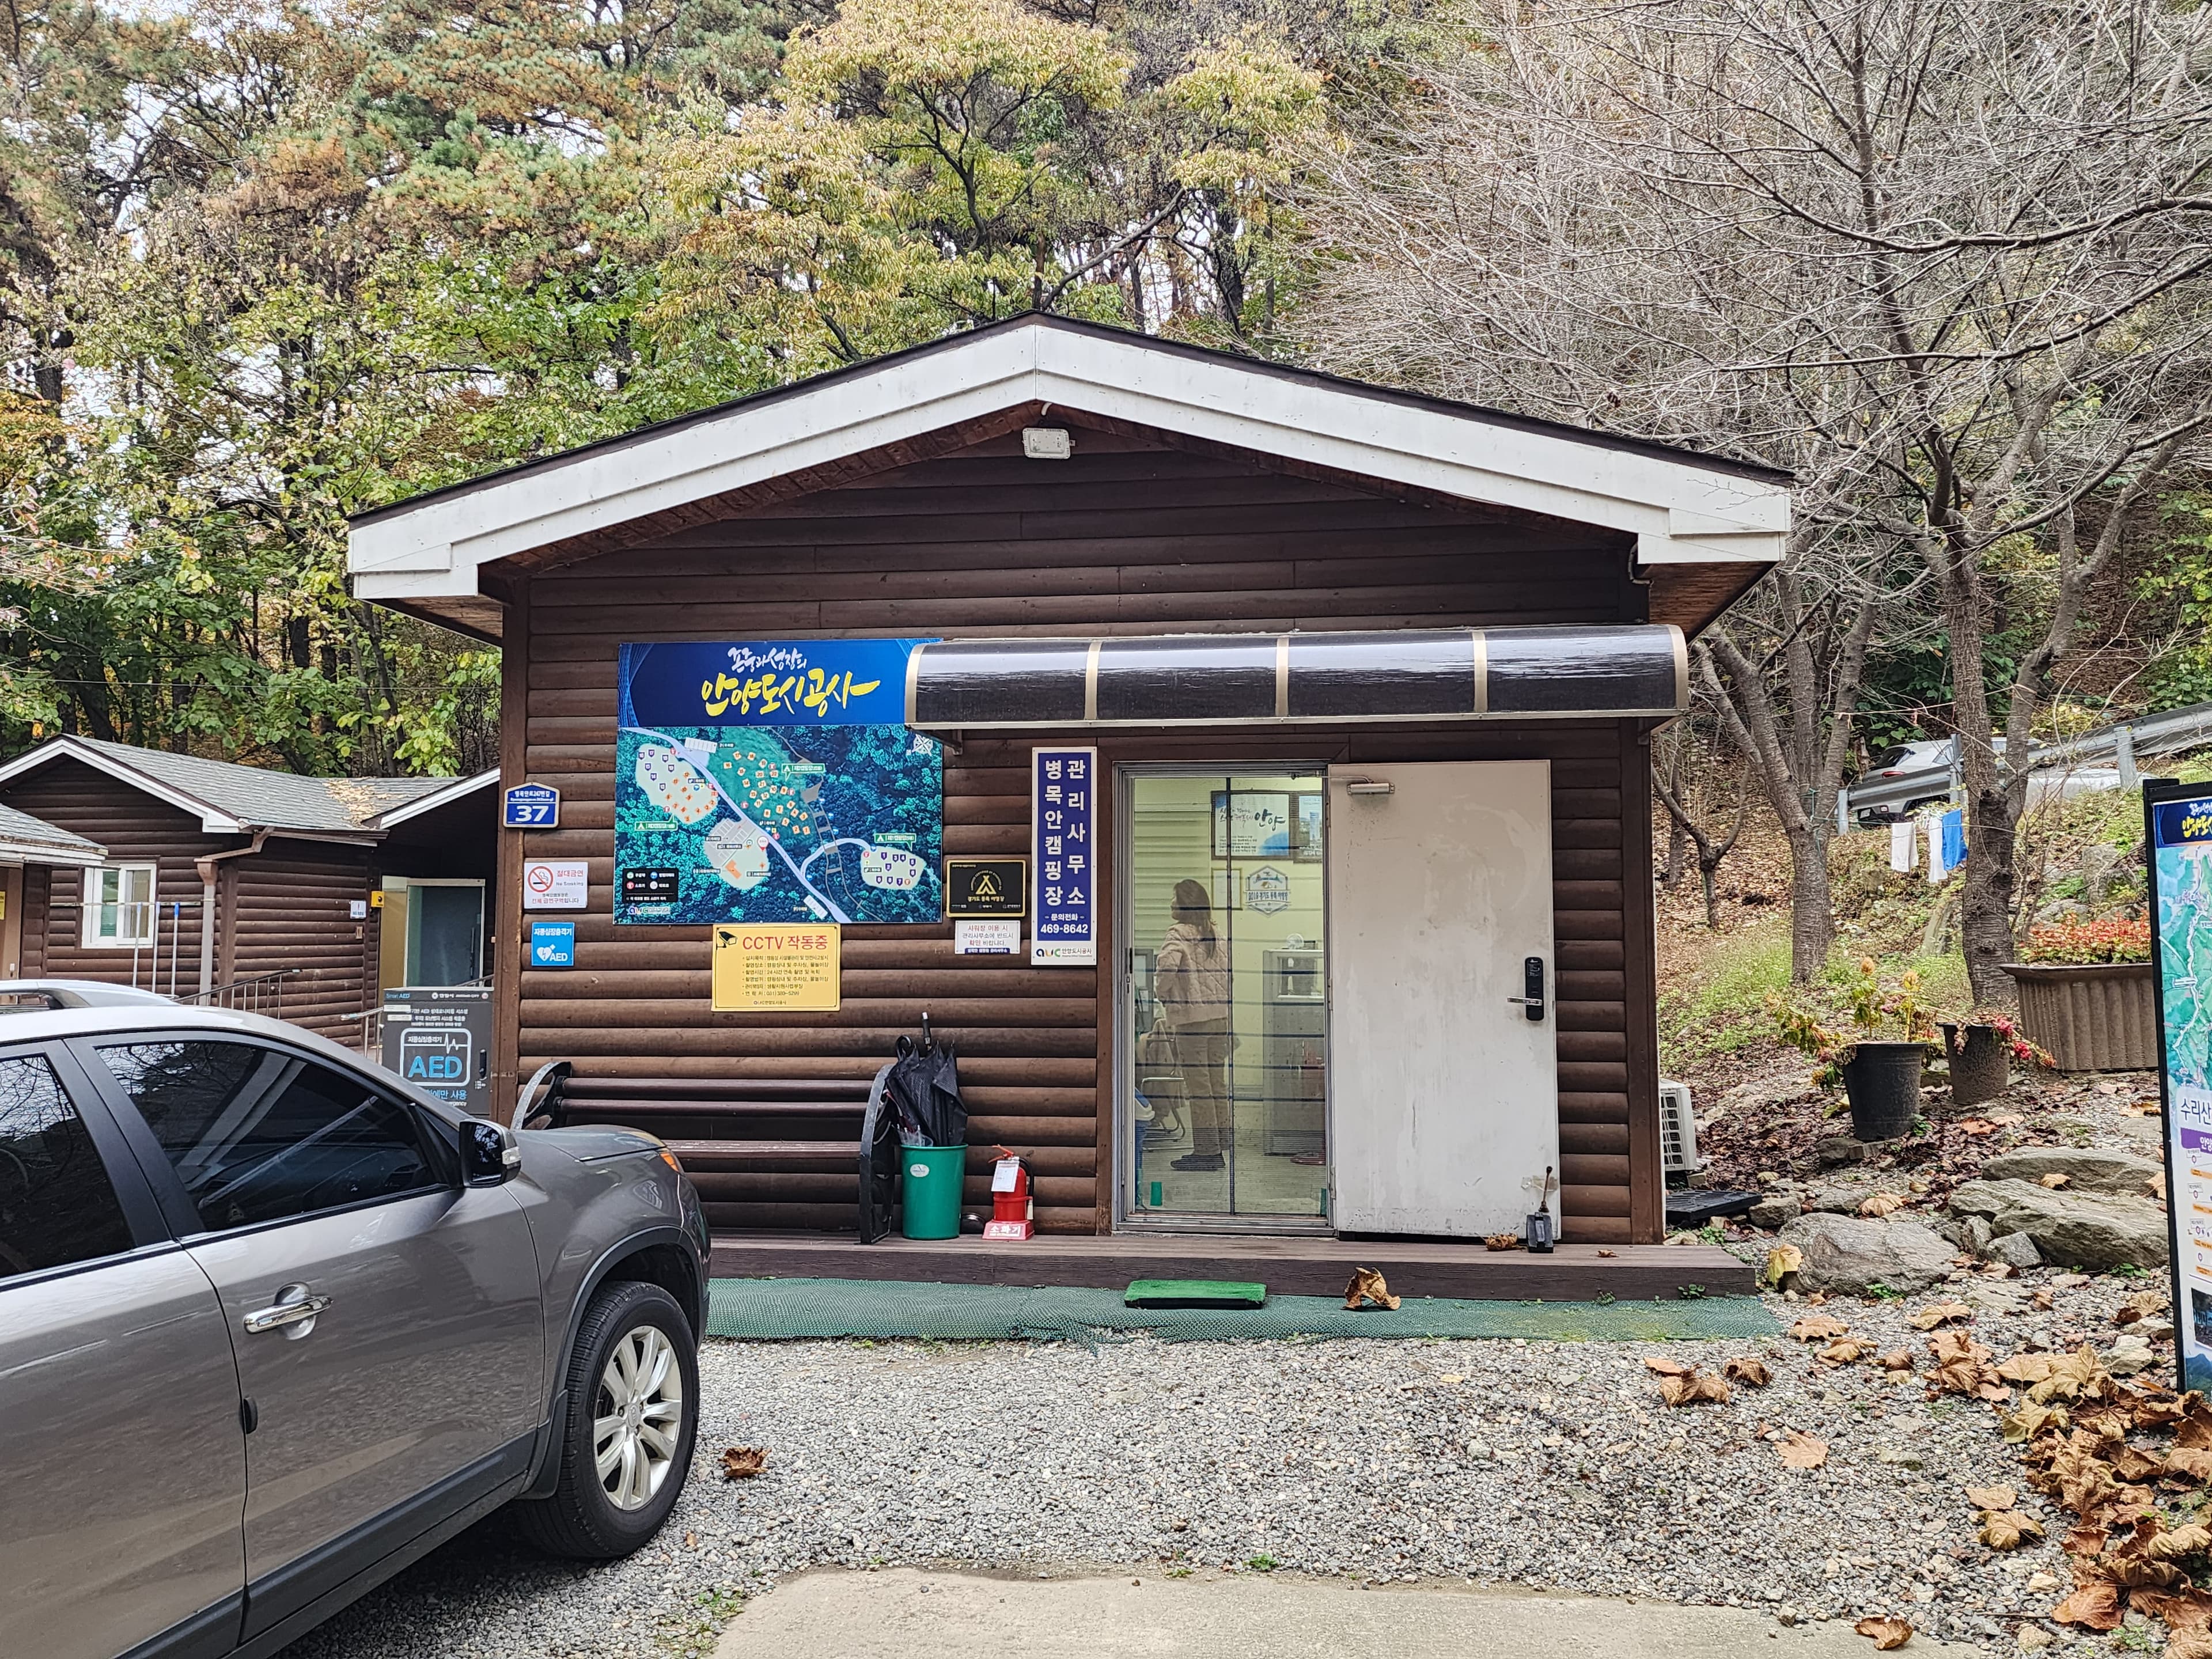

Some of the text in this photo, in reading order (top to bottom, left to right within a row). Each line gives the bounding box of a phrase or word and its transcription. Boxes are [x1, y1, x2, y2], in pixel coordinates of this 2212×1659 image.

[701, 668, 881, 717] 안양도시공사
[516, 805, 549, 822] 37
[1254, 808, 1286, 831] 안양
[1045, 760, 1063, 906] 병목안캠핑장
[1067, 760, 1086, 905] 관리사무소
[1051, 913, 1078, 921] 문의전화
[1040, 924, 1088, 933] 469-8642
[743, 935, 828, 950] CCTV 작동중
[550, 953, 568, 961] AED
[408, 1055, 463, 1078] AED
[450, 1089, 467, 1100] 사용
[989, 1225, 1021, 1234] 소화기
